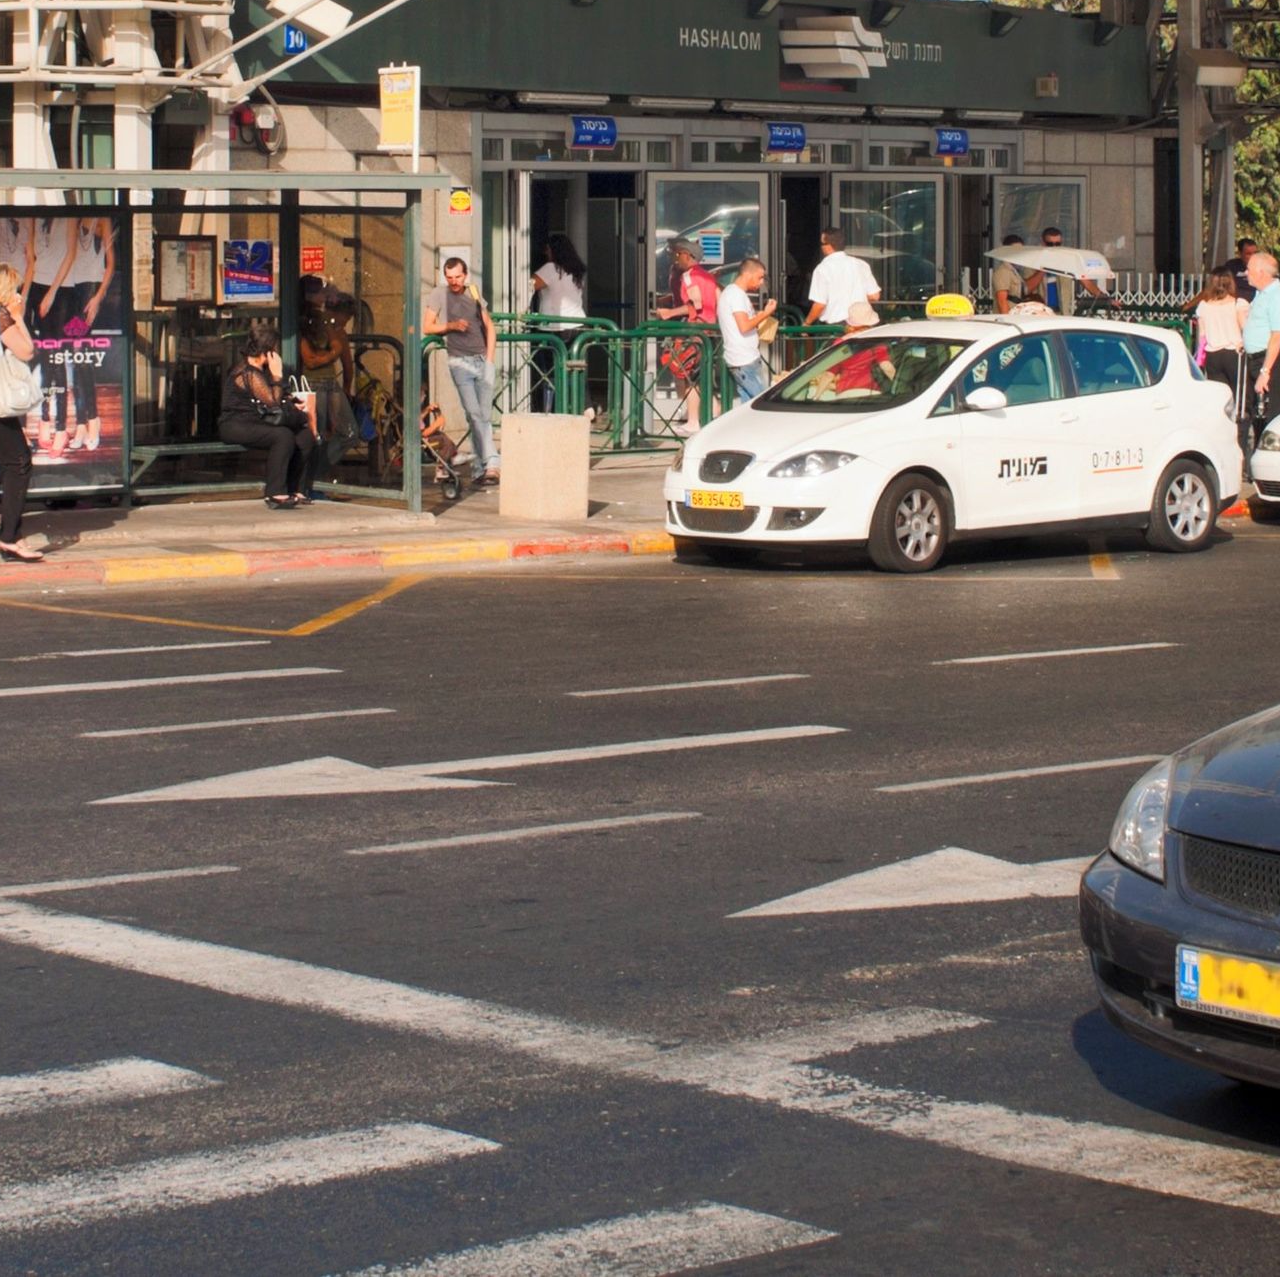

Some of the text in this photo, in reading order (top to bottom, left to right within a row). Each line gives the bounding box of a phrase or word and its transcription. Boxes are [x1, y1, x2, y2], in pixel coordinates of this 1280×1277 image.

[288, 30, 304, 49] 10
[679, 27, 762, 51] HASHALOM
[914, 43, 942, 62] תחנת
[581, 120, 608, 131] כניסה
[228, 240, 271, 273] 32
[49, 350, 106, 367] :story
